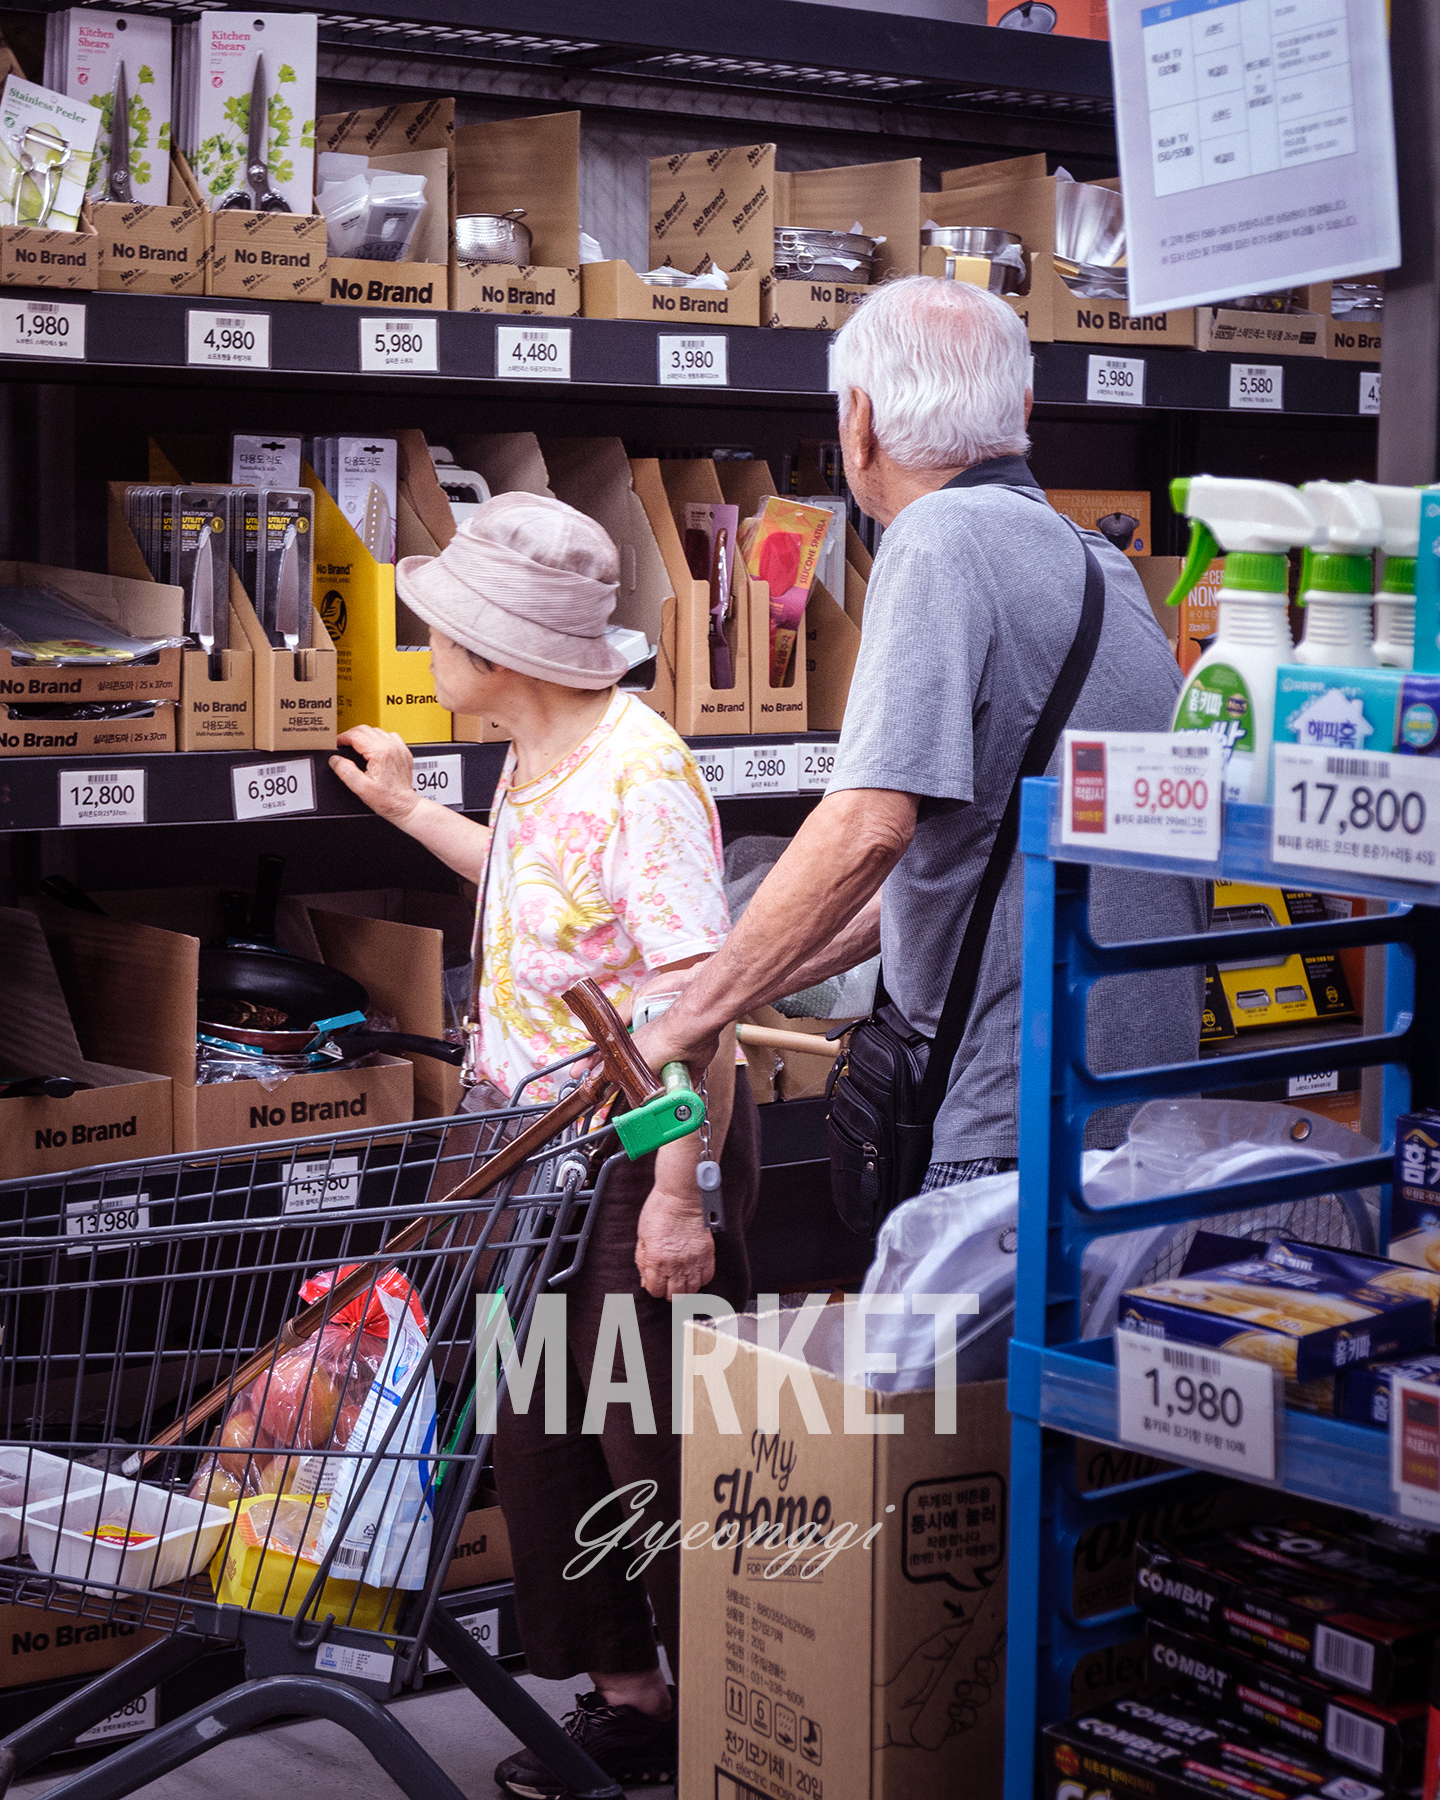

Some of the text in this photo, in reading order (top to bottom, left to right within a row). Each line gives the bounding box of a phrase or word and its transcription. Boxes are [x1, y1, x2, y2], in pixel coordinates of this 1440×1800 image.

[77, 37, 110, 49] Shears
[78, 26, 114, 40] Kitchen
[212, 30, 251, 42] Kitchen
[211, 41, 246, 52] Shears
[9, 87, 54, 112] Stainless
[55, 105, 87, 124] Peeler
[654, 191, 687, 235] No Brand
[692, 188, 726, 231] No Brand
[731, 185, 766, 229] No Brand
[15, 248, 87, 267] No Brand
[112, 243, 188, 262] No Brand
[235, 249, 310, 268] No Brand
[330, 278, 433, 304] No Brand
[482, 285, 556, 306] No Brand
[811, 285, 833, 302] No
[652, 293, 729, 314] No Brand
[15, 313, 70, 338] 1,980
[1076, 309, 1168, 332] No Brand
[203, 329, 255, 352] 4,980
[374, 333, 423, 356] 5,980
[1334, 332, 1355, 348] No
[512, 343, 557, 364] 4,480
[671, 351, 714, 371] 3,980
[1098, 369, 1134, 388] 5,980
[1239, 377, 1273, 397] 5,580
[239, 453, 283, 465] 다용도 식도
[344, 456, 381, 466] 다용도 식도
[1072, 495, 1142, 508] CERAMIC COATING
[182, 516, 206, 524] UTILITY
[267, 516, 291, 524] UTILITY
[799, 518, 828, 585] SILICONE SPATULA
[316, 563, 328, 574] No
[0, 678, 82, 695] No Brand
[97, 680, 134, 691] 실리콘도마
[139, 680, 148, 690] 25
[154, 680, 173, 690] 37cm
[193, 701, 247, 712] No Brand
[280, 697, 332, 709] No Brand
[386, 695, 403, 706] No
[701, 701, 745, 714] No Brand
[760, 701, 803, 714] No Brand
[202, 720, 239, 731] 다용도과도
[288, 716, 324, 727] 다용도과도
[0, 731, 78, 748] No Brand
[93, 733, 129, 744] 실리콘도마
[134, 732, 143, 741] 25
[149, 731, 167, 741] 37cm
[745, 759, 786, 780] 2,980
[70, 785, 135, 809] 12,800
[248, 775, 298, 802] 6,980
[1134, 777, 1209, 814] 9,800
[262, 801, 287, 810] 다용도과도
[1291, 780, 1427, 835] 17,800
[249, 1093, 368, 1129] No Brand
[34, 1115, 138, 1150] No Brand
[1145, 1367, 1244, 1428] 1,980
[1174, 1424, 1201, 1444] 모기향
[751, 1428, 798, 1492] My
[918, 1486, 991, 1511] 두개의 버튼을
[713, 1467, 835, 1577] Home
[911, 1504, 996, 1535] 동시에 눌러
[927, 1531, 980, 1549] 작동합니다
[746, 1562, 762, 1575] FOR
[726, 1587, 751, 1610] 상품코드
[1138, 1567, 1216, 1612] COMBAT
[11, 1612, 136, 1656] No Brand
[726, 1605, 784, 1644] 상품명 전기모기채
[726, 1640, 745, 1660] 수입원
[726, 1657, 745, 1679] 연락처
[1153, 1643, 1228, 1690] COMBAT
[1116, 1700, 1219, 1742] COMBAT
[1077, 1717, 1183, 1760] COMBAT
[721, 1750, 769, 1790] An electric
[725, 1728, 823, 1800] 전기모기채 20입
[1083, 1756, 1110, 1780] 최후의
